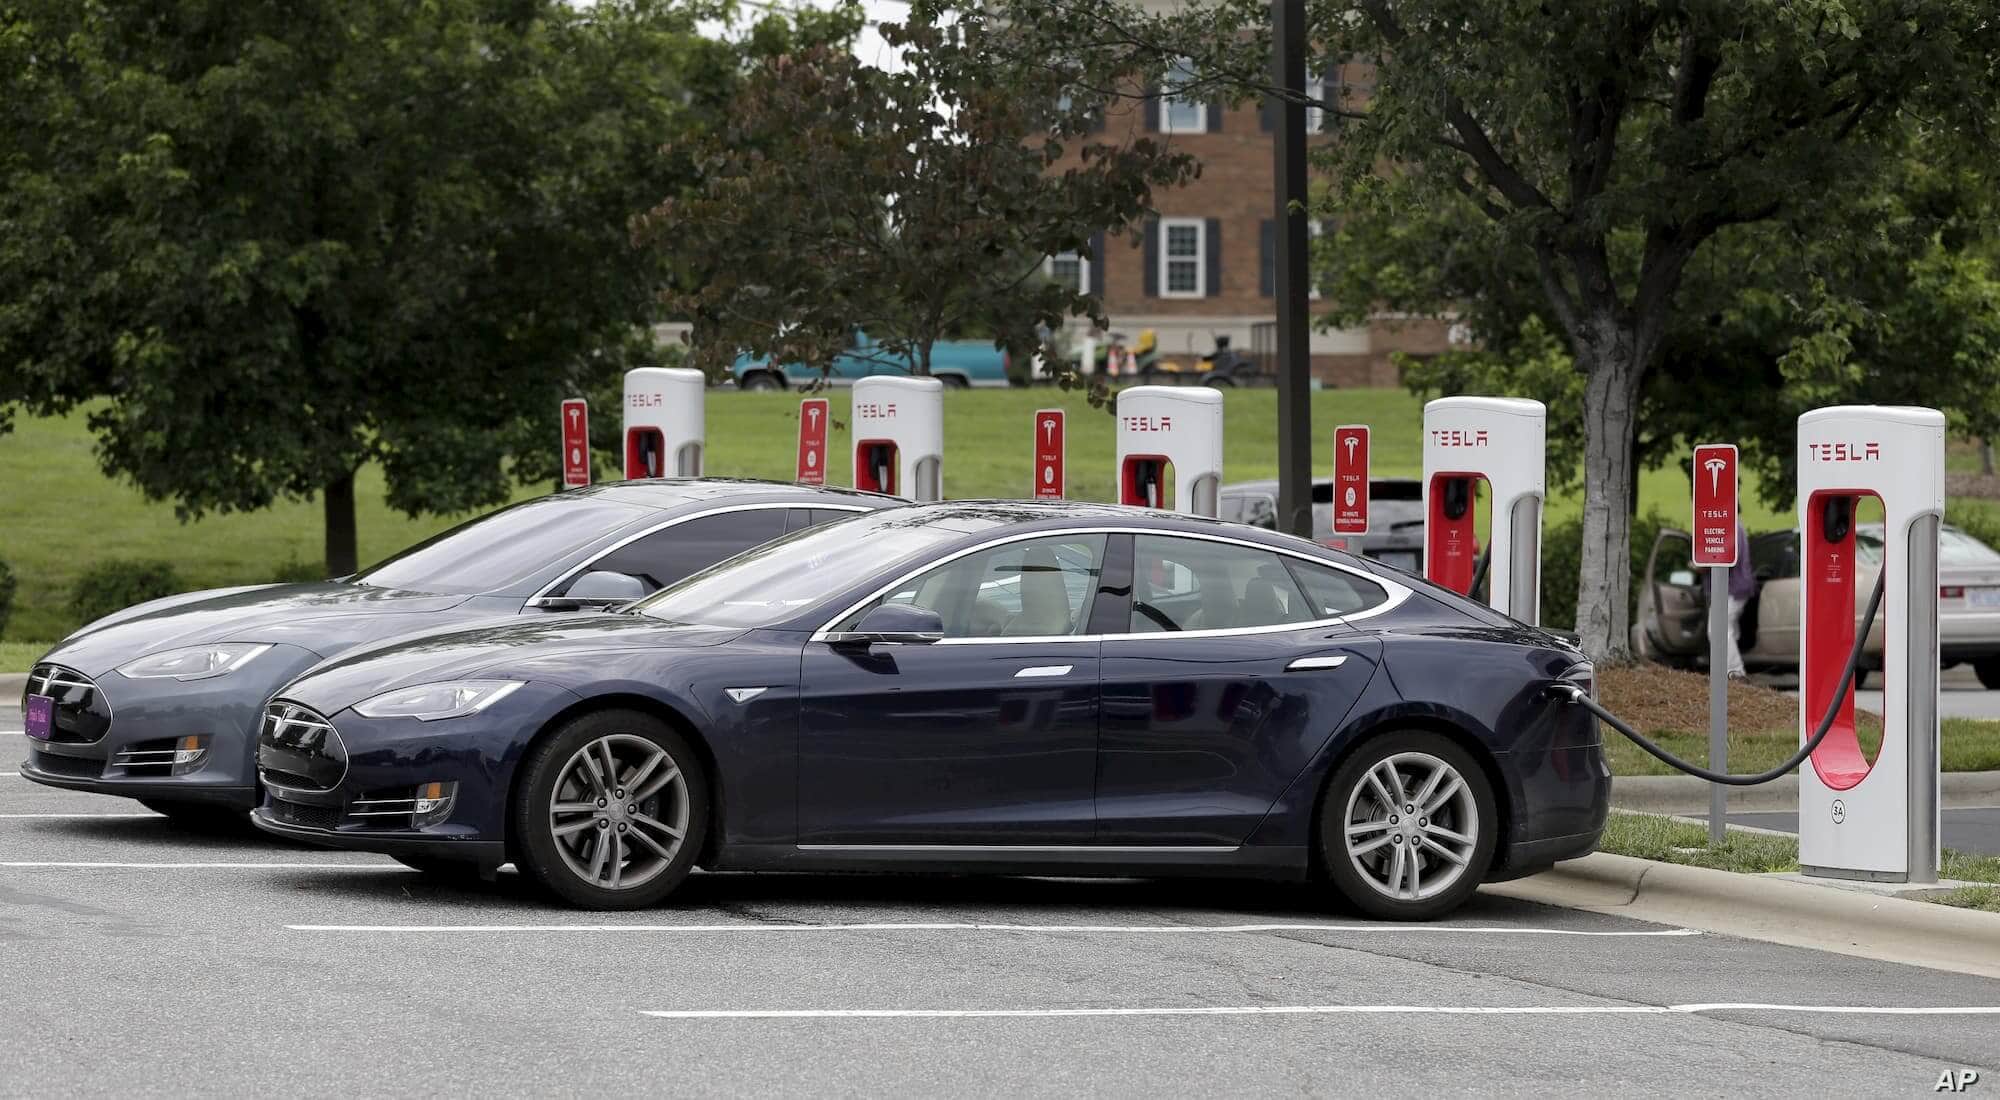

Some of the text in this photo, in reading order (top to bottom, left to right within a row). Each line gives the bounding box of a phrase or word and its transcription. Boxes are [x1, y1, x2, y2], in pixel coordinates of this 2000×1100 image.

[627, 394, 662, 407] TESLA
[857, 404, 896, 418] TESLA
[1122, 417, 1171, 432] TESLA
[1432, 431, 1488, 447] TESLA
[1809, 443, 1879, 461] TESLA
